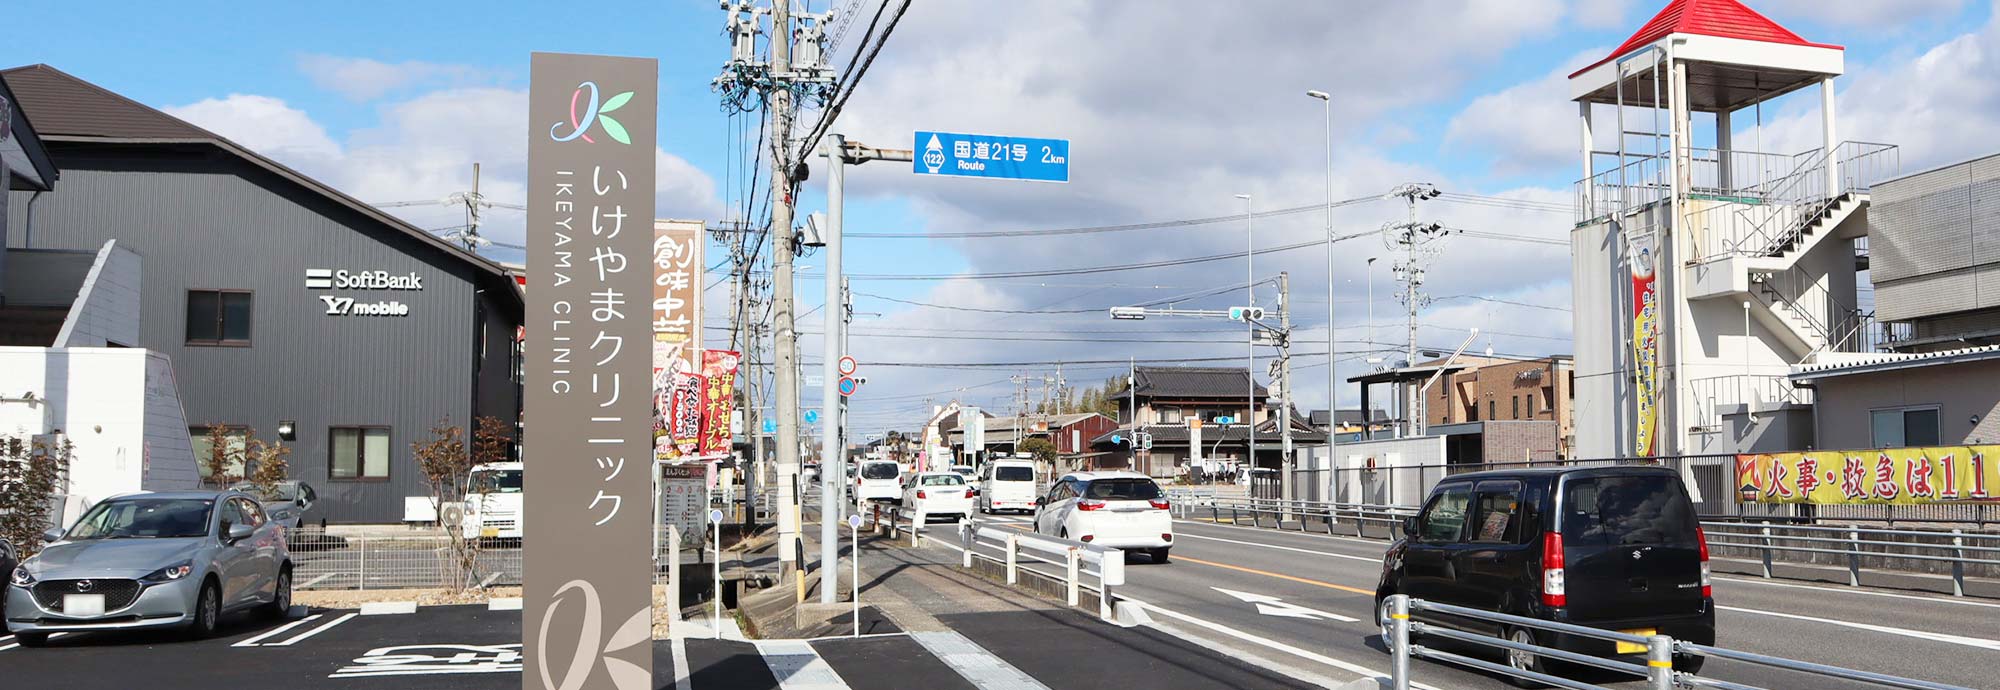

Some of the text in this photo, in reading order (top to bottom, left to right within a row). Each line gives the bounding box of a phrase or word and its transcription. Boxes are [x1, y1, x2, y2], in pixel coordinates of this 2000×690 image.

[926, 153, 942, 164] 122
[954, 140, 1065, 165] 国道21号 2km
[957, 160, 985, 171] Route
[335, 269, 422, 289] SoftBank
[552, 170, 574, 395] IKEYAMA CLINIC
[588, 165, 628, 526] いけやまクリニック
[841, 361, 852, 370] 50
[1766, 452, 2000, 500] 火事・救急は11
